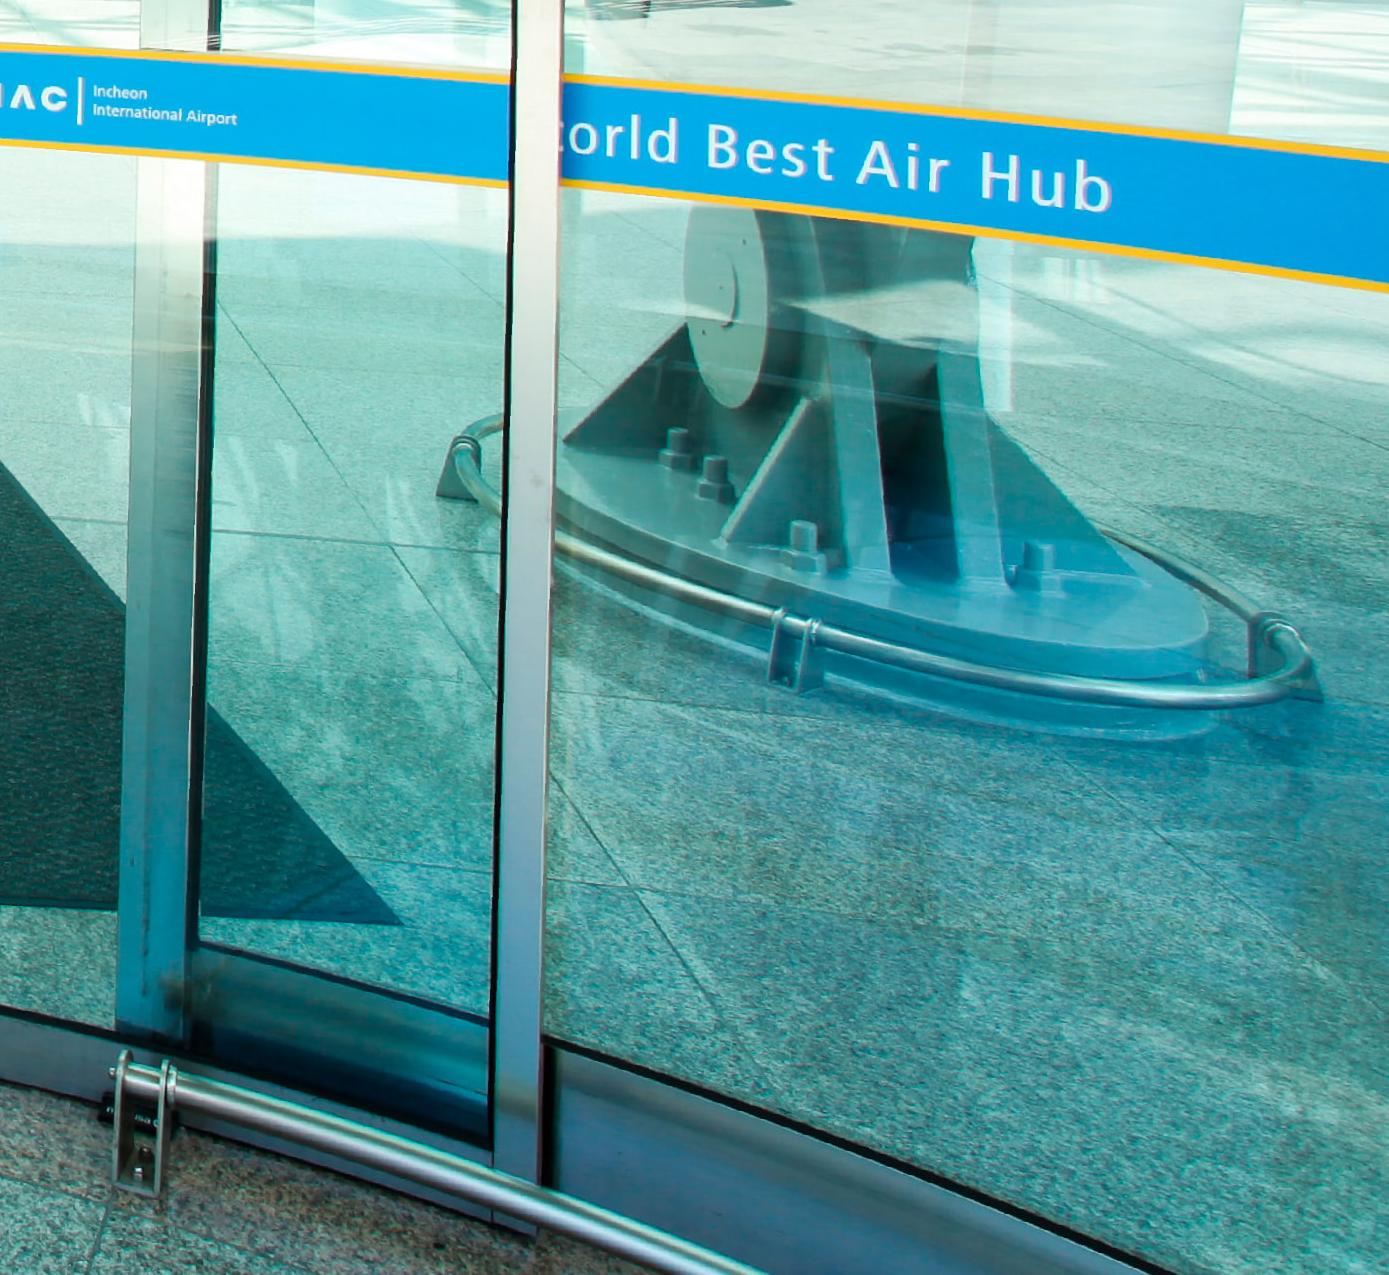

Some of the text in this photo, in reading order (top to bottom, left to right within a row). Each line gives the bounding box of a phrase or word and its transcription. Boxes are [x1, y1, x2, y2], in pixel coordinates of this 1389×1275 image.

[93, 84, 148, 100] Incheon
[93, 103, 238, 127] International Airport
[559, 113, 1112, 214] orld Best Air Hub
